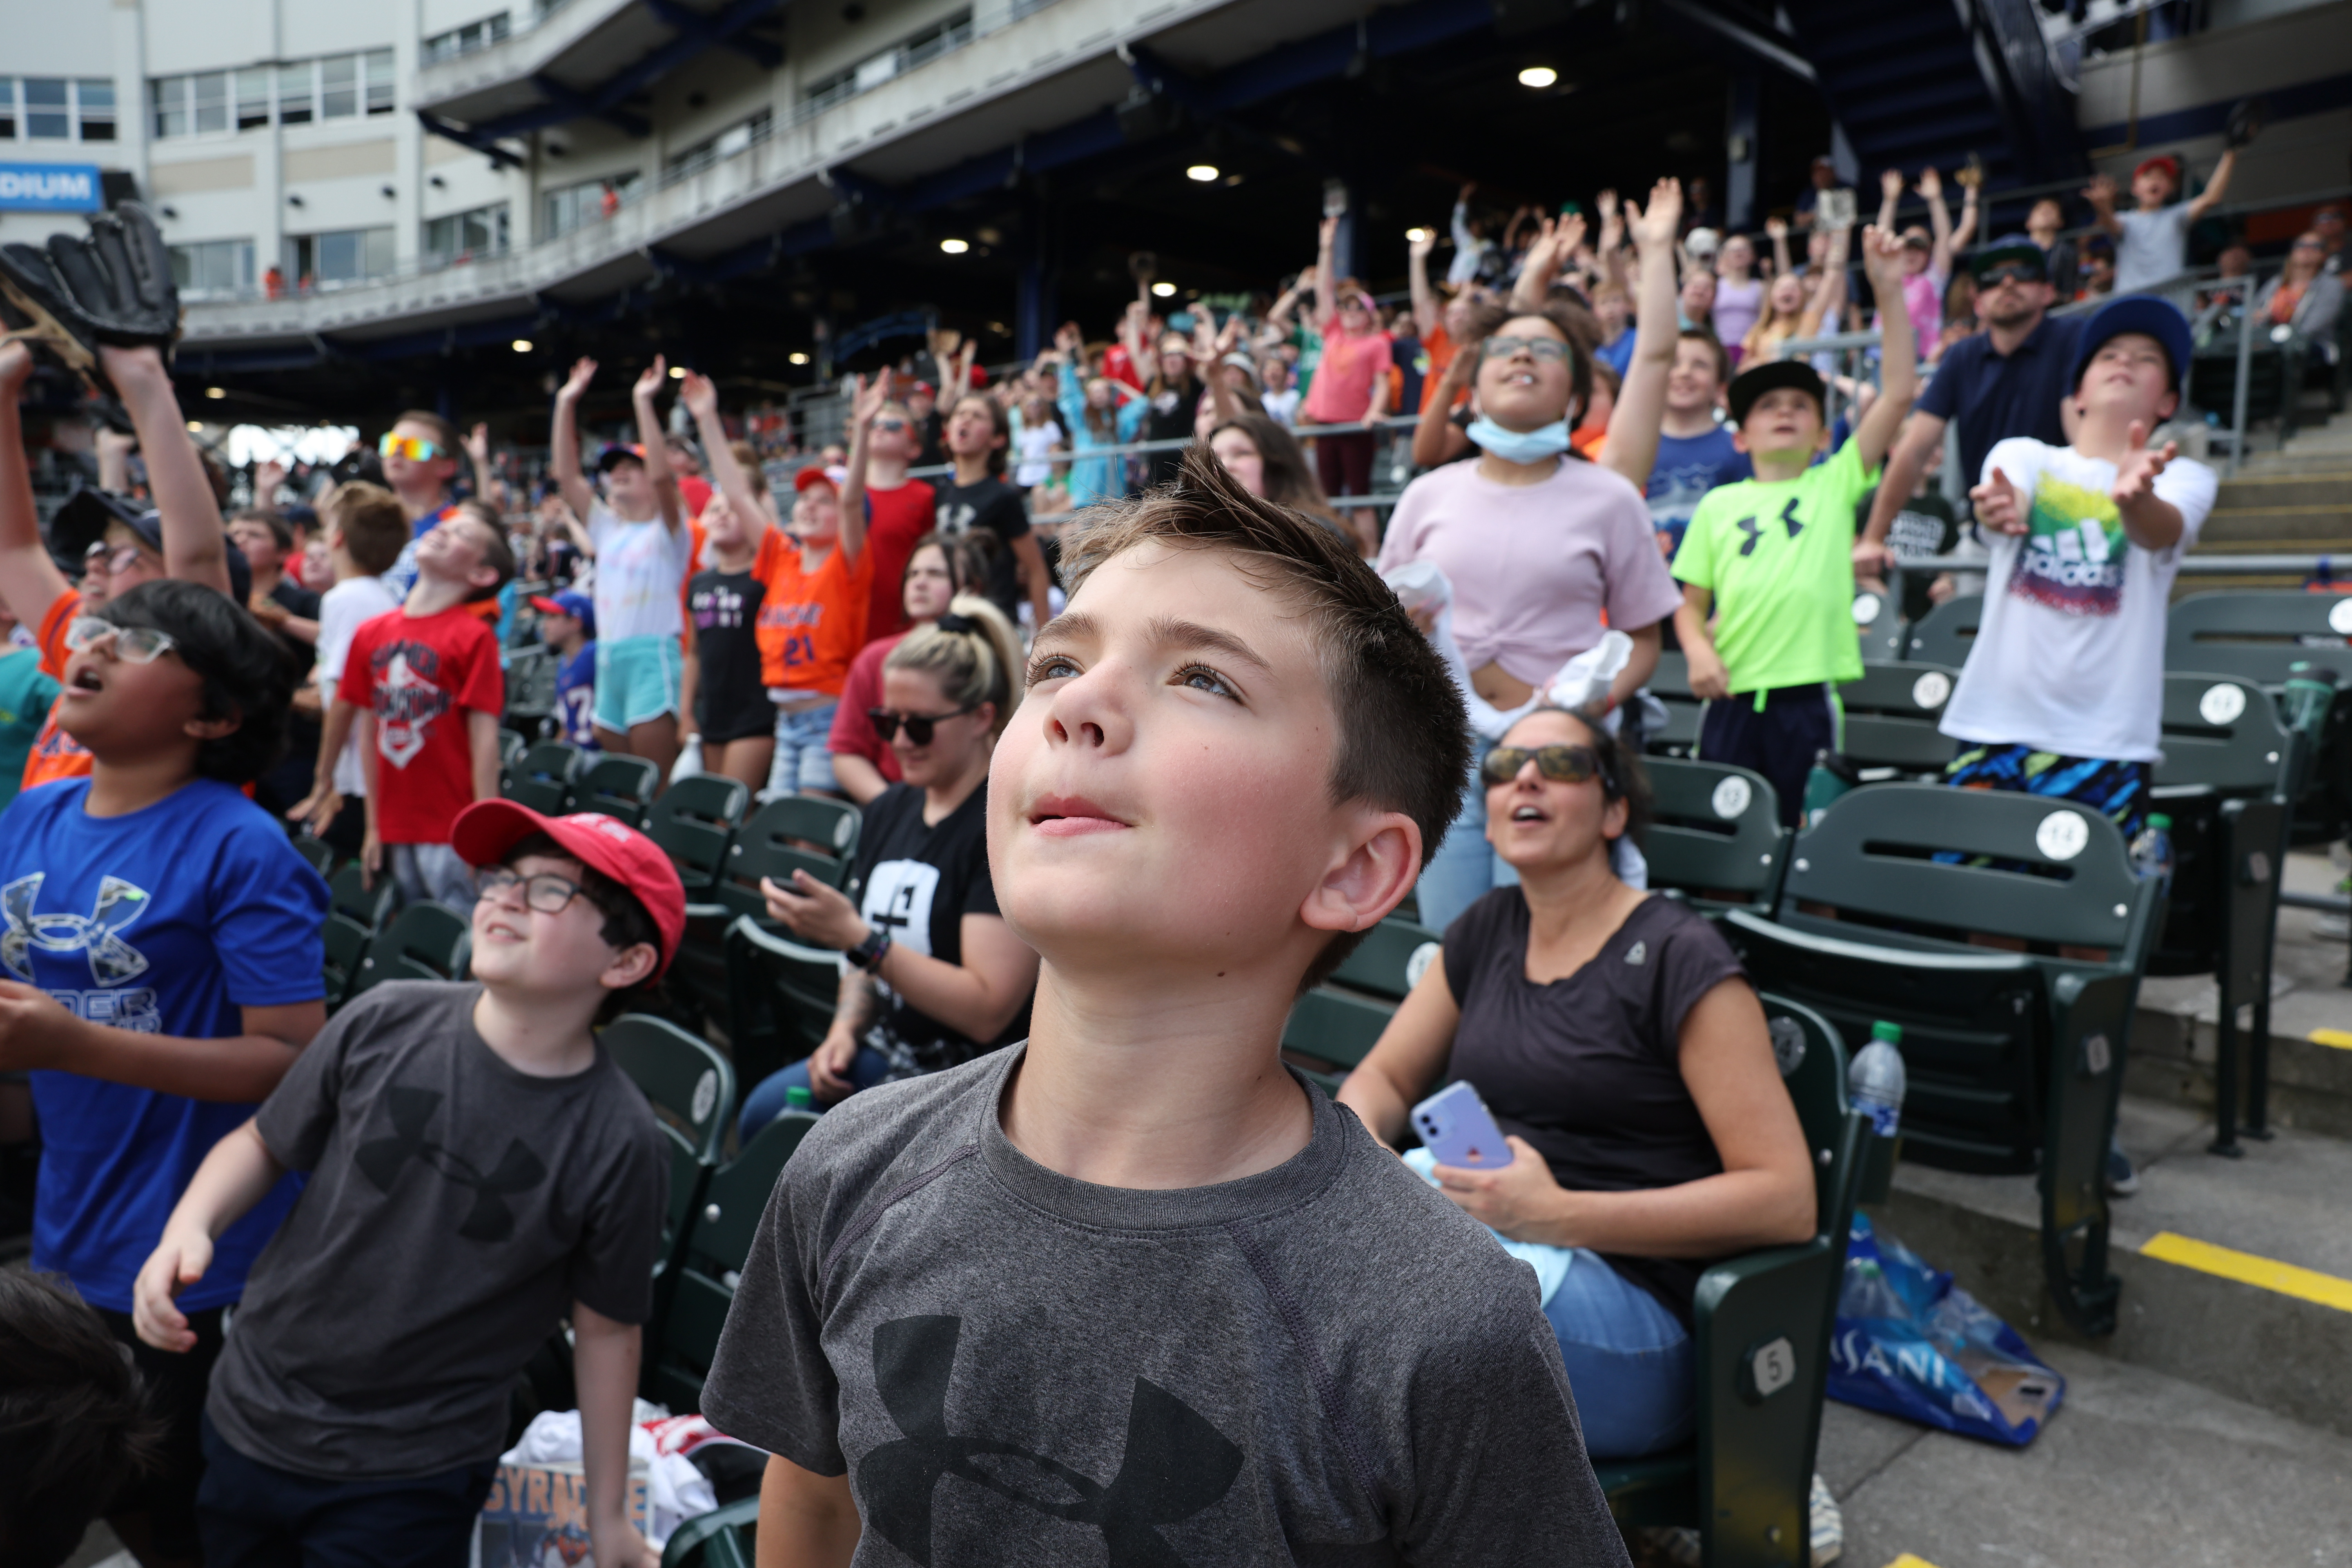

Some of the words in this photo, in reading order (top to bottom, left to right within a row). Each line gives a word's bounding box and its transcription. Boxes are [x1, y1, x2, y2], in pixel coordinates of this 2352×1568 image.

[785, 636, 813, 666] 21
[1766, 1349, 1783, 1383] 5
[1830, 1330, 1945, 1388] SANI
[485, 1465, 646, 1519] SYRACE
